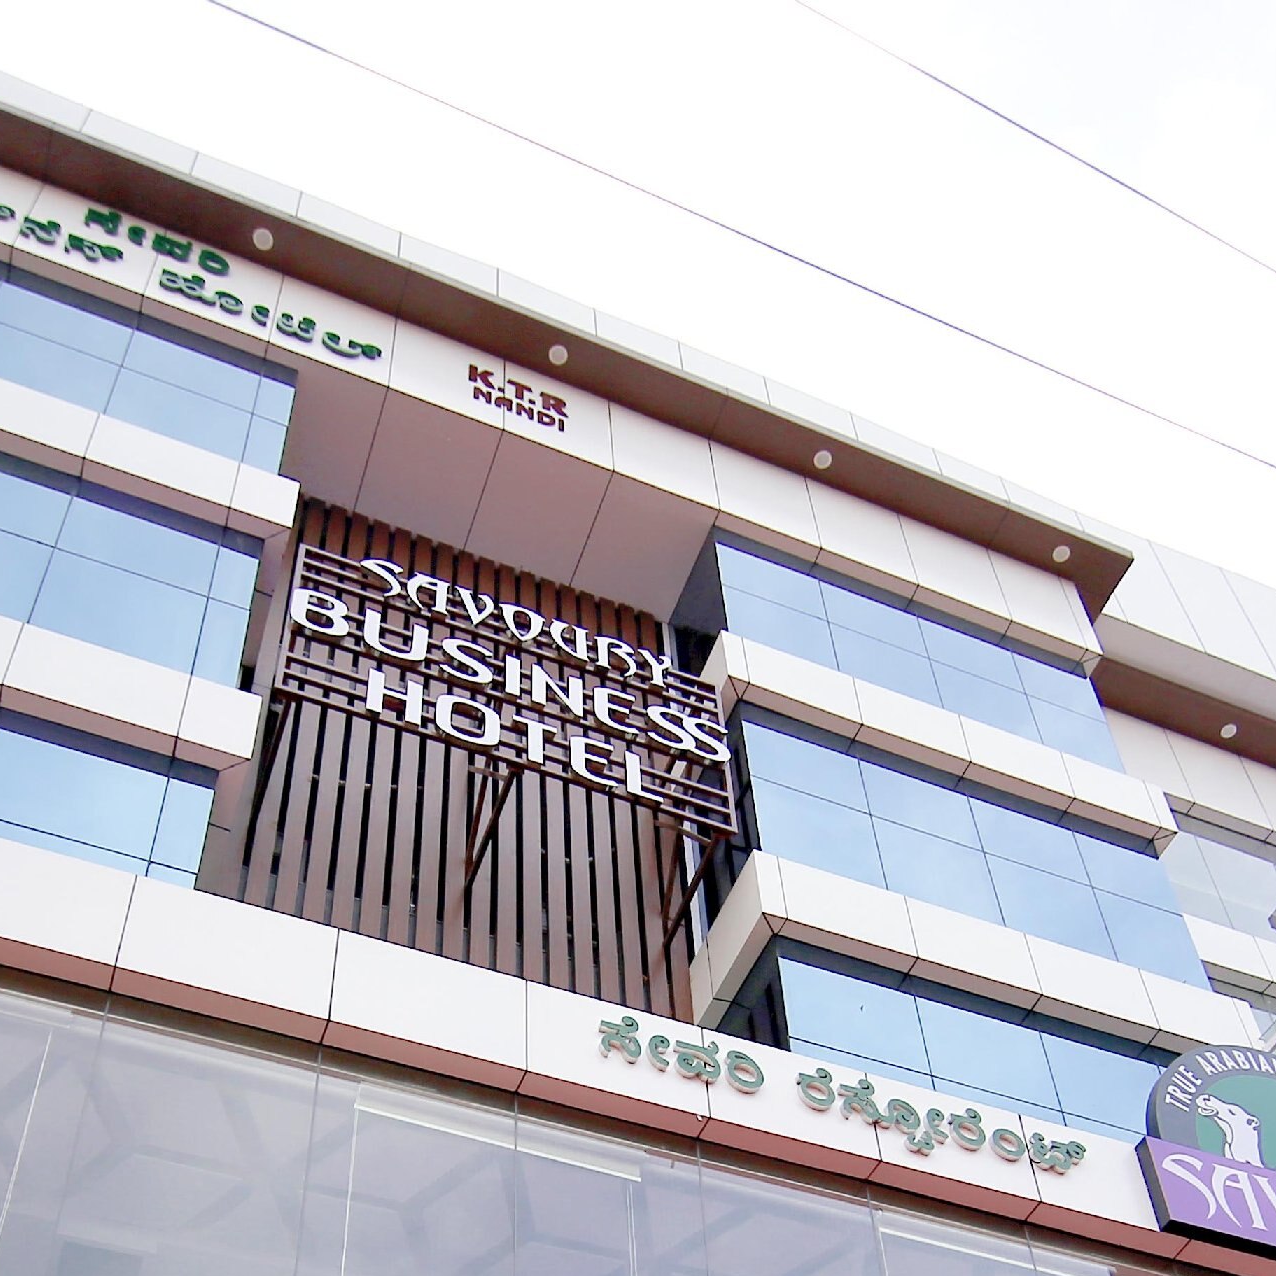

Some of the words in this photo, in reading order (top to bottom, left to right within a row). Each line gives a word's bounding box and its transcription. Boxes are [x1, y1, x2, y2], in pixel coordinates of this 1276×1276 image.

[468, 363, 569, 418] K.T.R
[473, 386, 565, 433] NANDI
[359, 557, 673, 689] SAVOURY
[289, 587, 732, 763] BUSINESS
[365, 667, 665, 803] HOTEL
[599, 1016, 765, 1094] ಸೇವರಿ
[1164, 1064, 1203, 1113] TRUE
